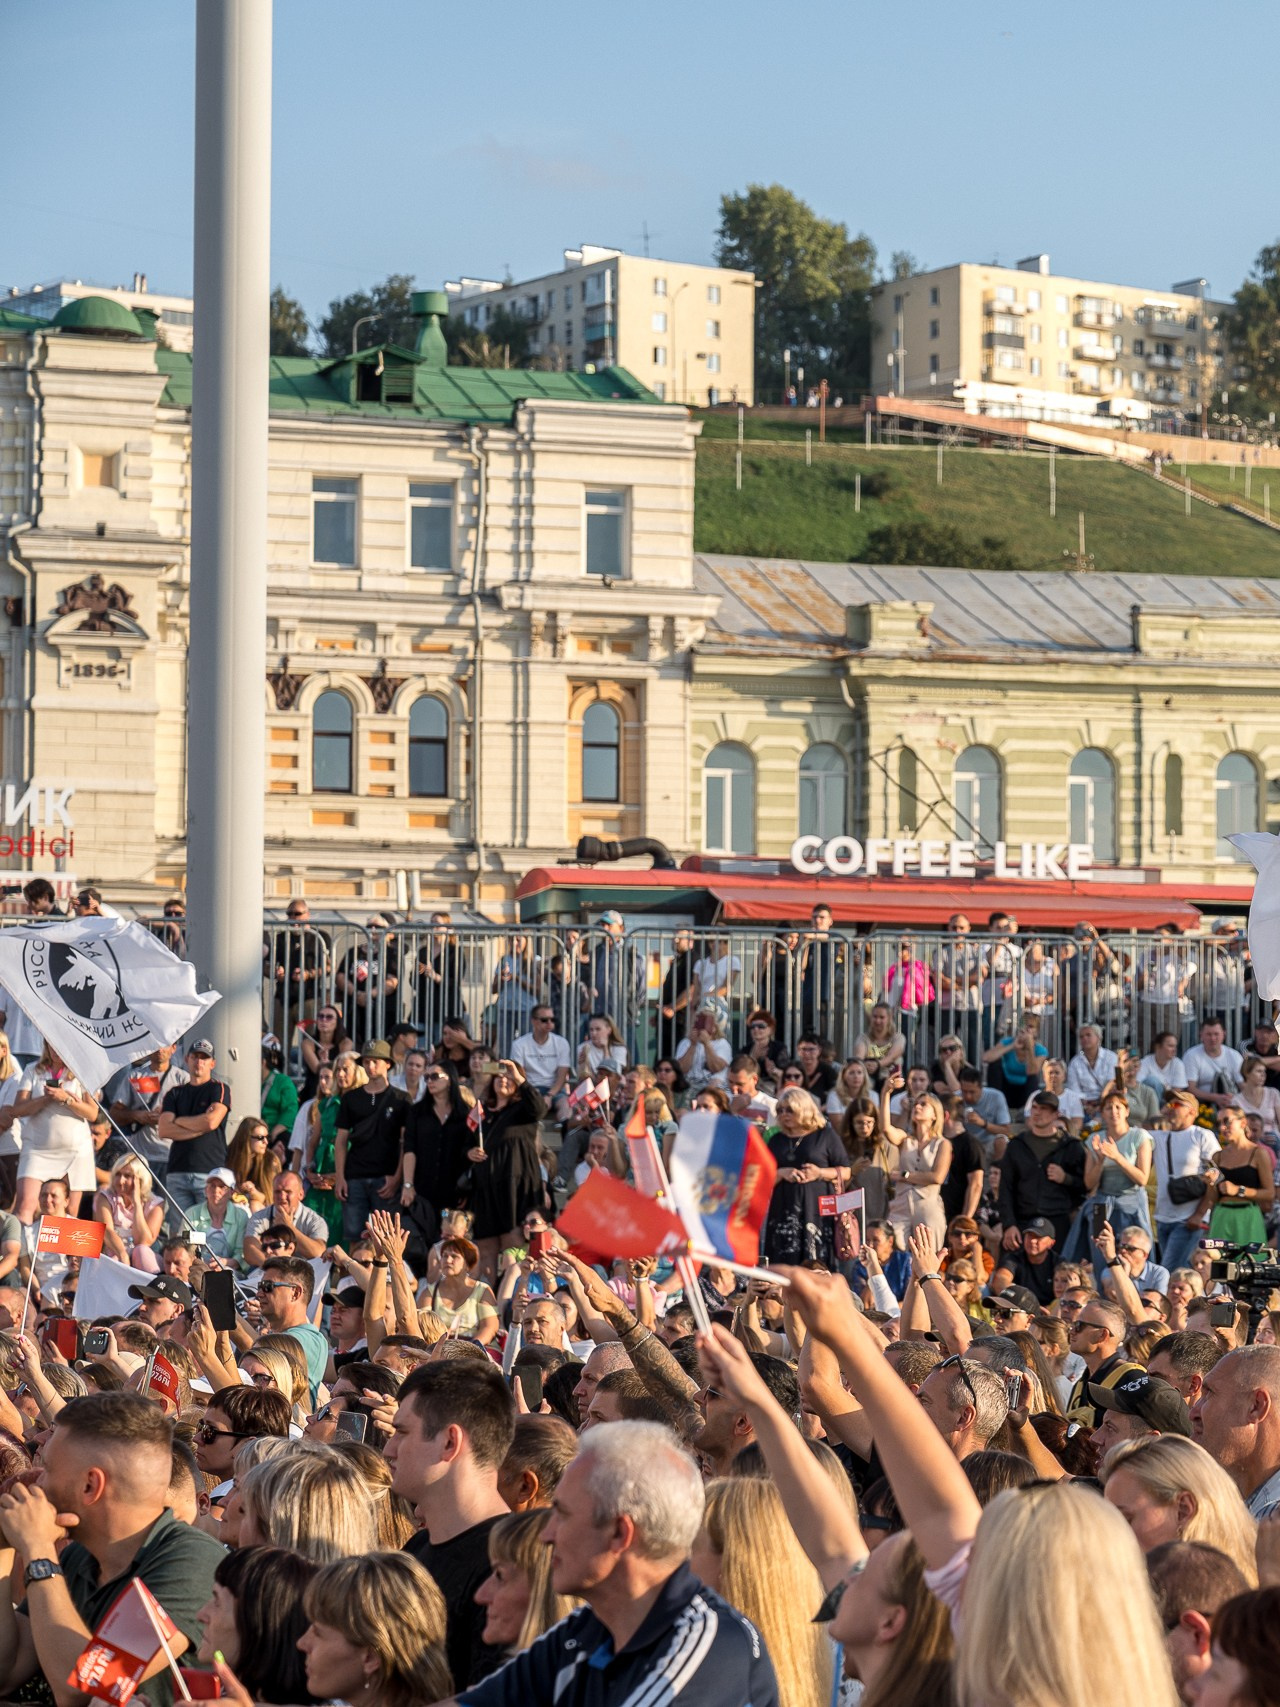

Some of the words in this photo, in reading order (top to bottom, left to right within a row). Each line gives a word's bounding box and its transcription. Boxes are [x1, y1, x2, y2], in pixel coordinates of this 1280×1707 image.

[0, 784, 75, 827] ИК
[791, 835, 976, 877] COFFEE
[995, 841, 1094, 880] LIKE
